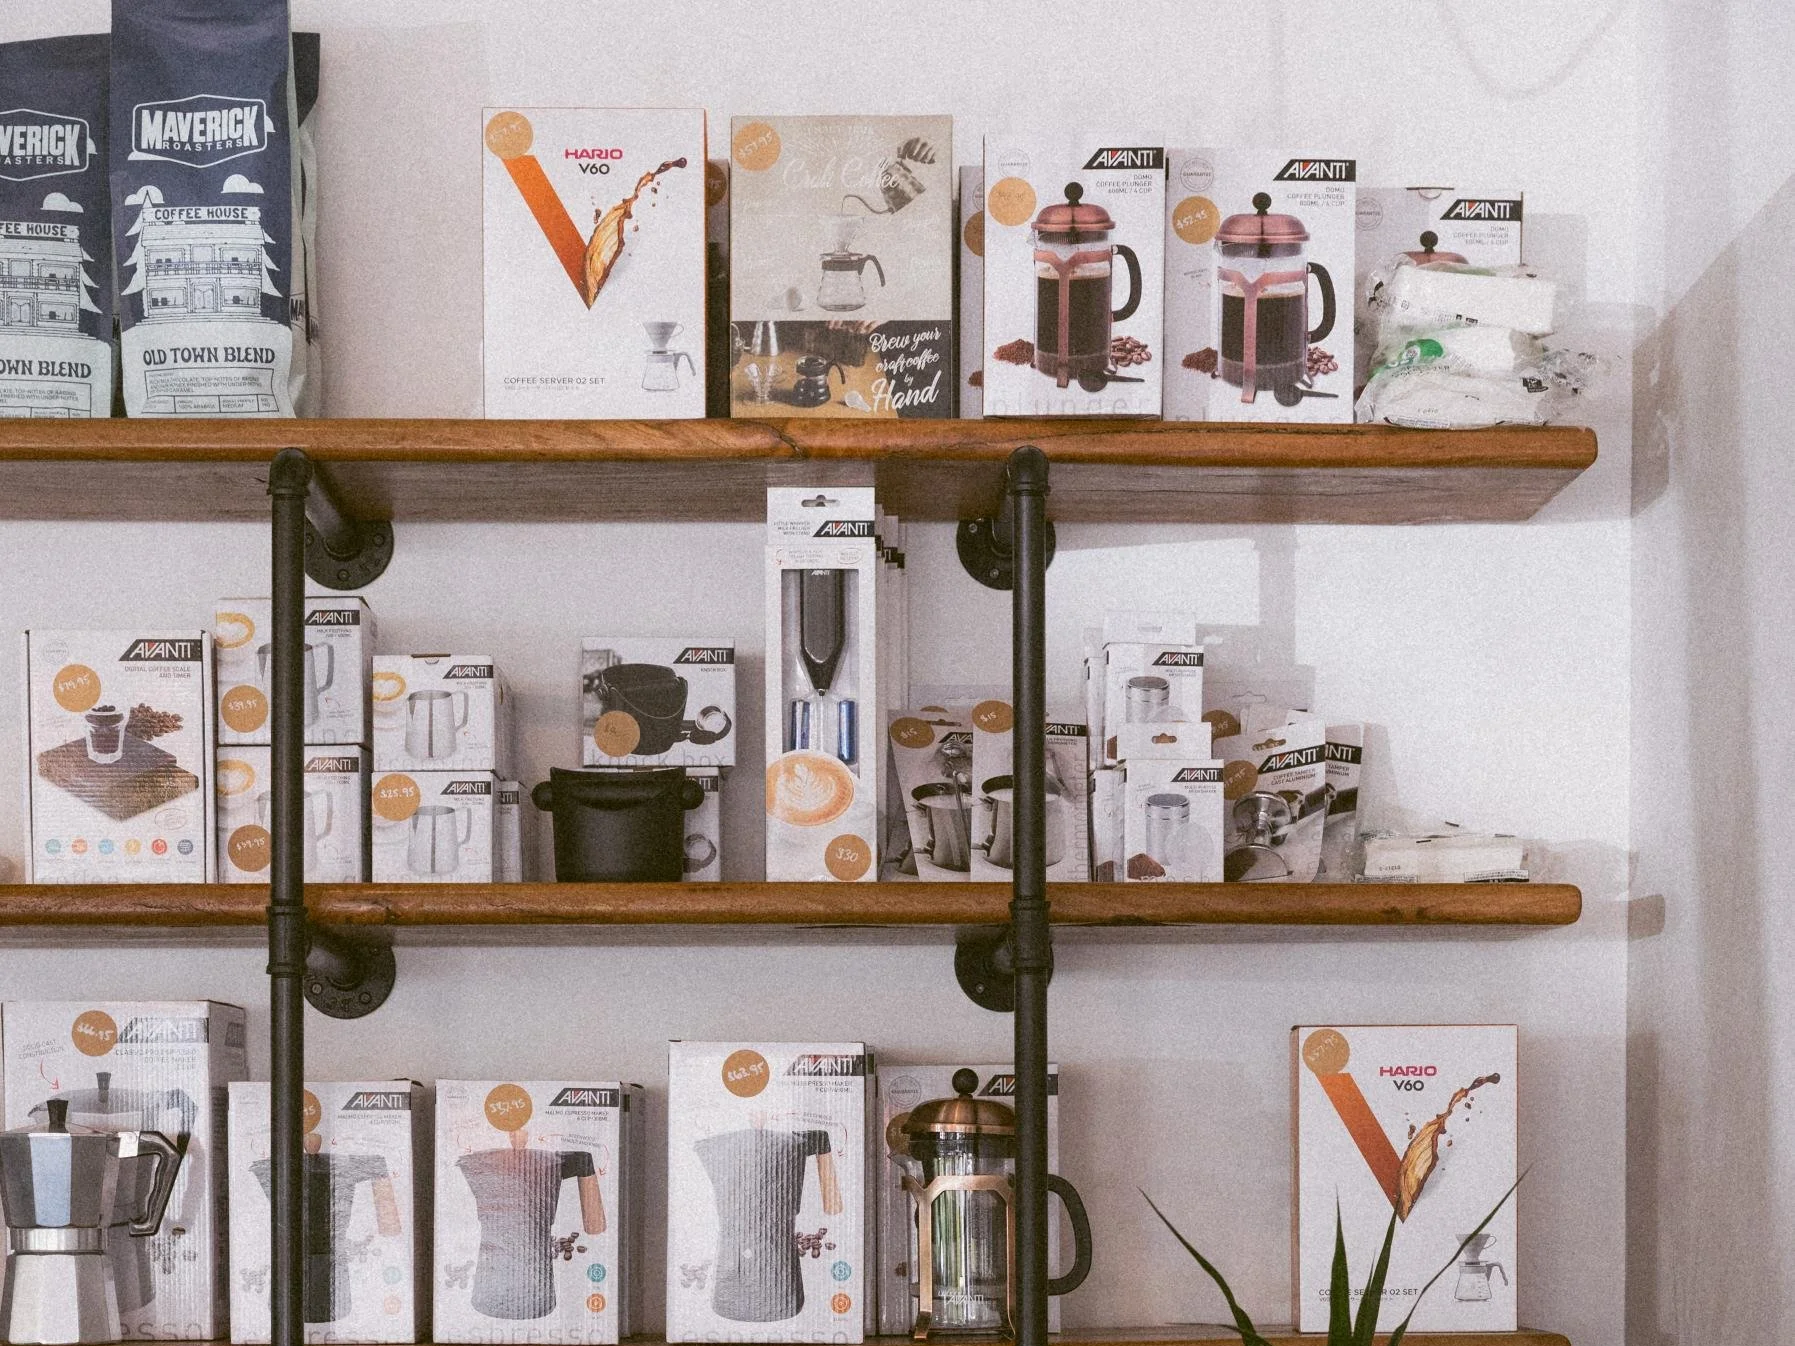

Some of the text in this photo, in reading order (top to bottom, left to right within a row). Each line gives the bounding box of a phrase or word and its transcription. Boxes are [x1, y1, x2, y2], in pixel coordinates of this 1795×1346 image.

[141, 105, 258, 149] MAVERICK
[162, 139, 243, 151] ROASTERS
[564, 148, 623, 160] HARIO
[1093, 150, 1154, 167] AVANTI
[578, 163, 610, 175] V60
[1284, 162, 1347, 179] AVANTI
[154, 207, 248, 220] COFFEE HOUSE
[1450, 202, 1510, 219] AVANTI
[26, 225, 67, 237] HOUSE
[869, 326, 942, 353] Brew your
[143, 346, 275, 365] OLD TOWN BLEND
[875, 348, 940, 375] craft coffee
[38, 360, 92, 378] BLEND
[503, 377, 536, 385] COFFEE
[539, 377, 575, 385] SERVER
[589, 377, 605, 385] SET
[904, 373, 914, 387] by
[871, 369, 942, 414] Hand
[821, 522, 869, 535] AVANTI
[308, 612, 353, 624] AVANTI
[130, 642, 192, 659] AVANTI
[680, 650, 727, 662] AVANTI
[1159, 653, 1198, 665] AVANTI
[449, 667, 488, 677] AVANTI
[979, 711, 997, 723] $15
[308, 759, 351, 771] AVANTI
[1263, 748, 1317, 772] AVANTI
[1178, 769, 1218, 781] AVANTI
[380, 786, 415, 798] $25.95
[447, 782, 486, 793] AVANTI
[835, 848, 859, 863] $30
[727, 1060, 765, 1082] $63.95
[794, 1057, 853, 1073] AVANTI
[1379, 1065, 1438, 1077] HARIO
[1393, 1080, 1424, 1092] V60
[352, 1094, 402, 1108] AVANTI
[559, 1090, 610, 1104] AVANTI
[1402, 1288, 1418, 1296] SET
